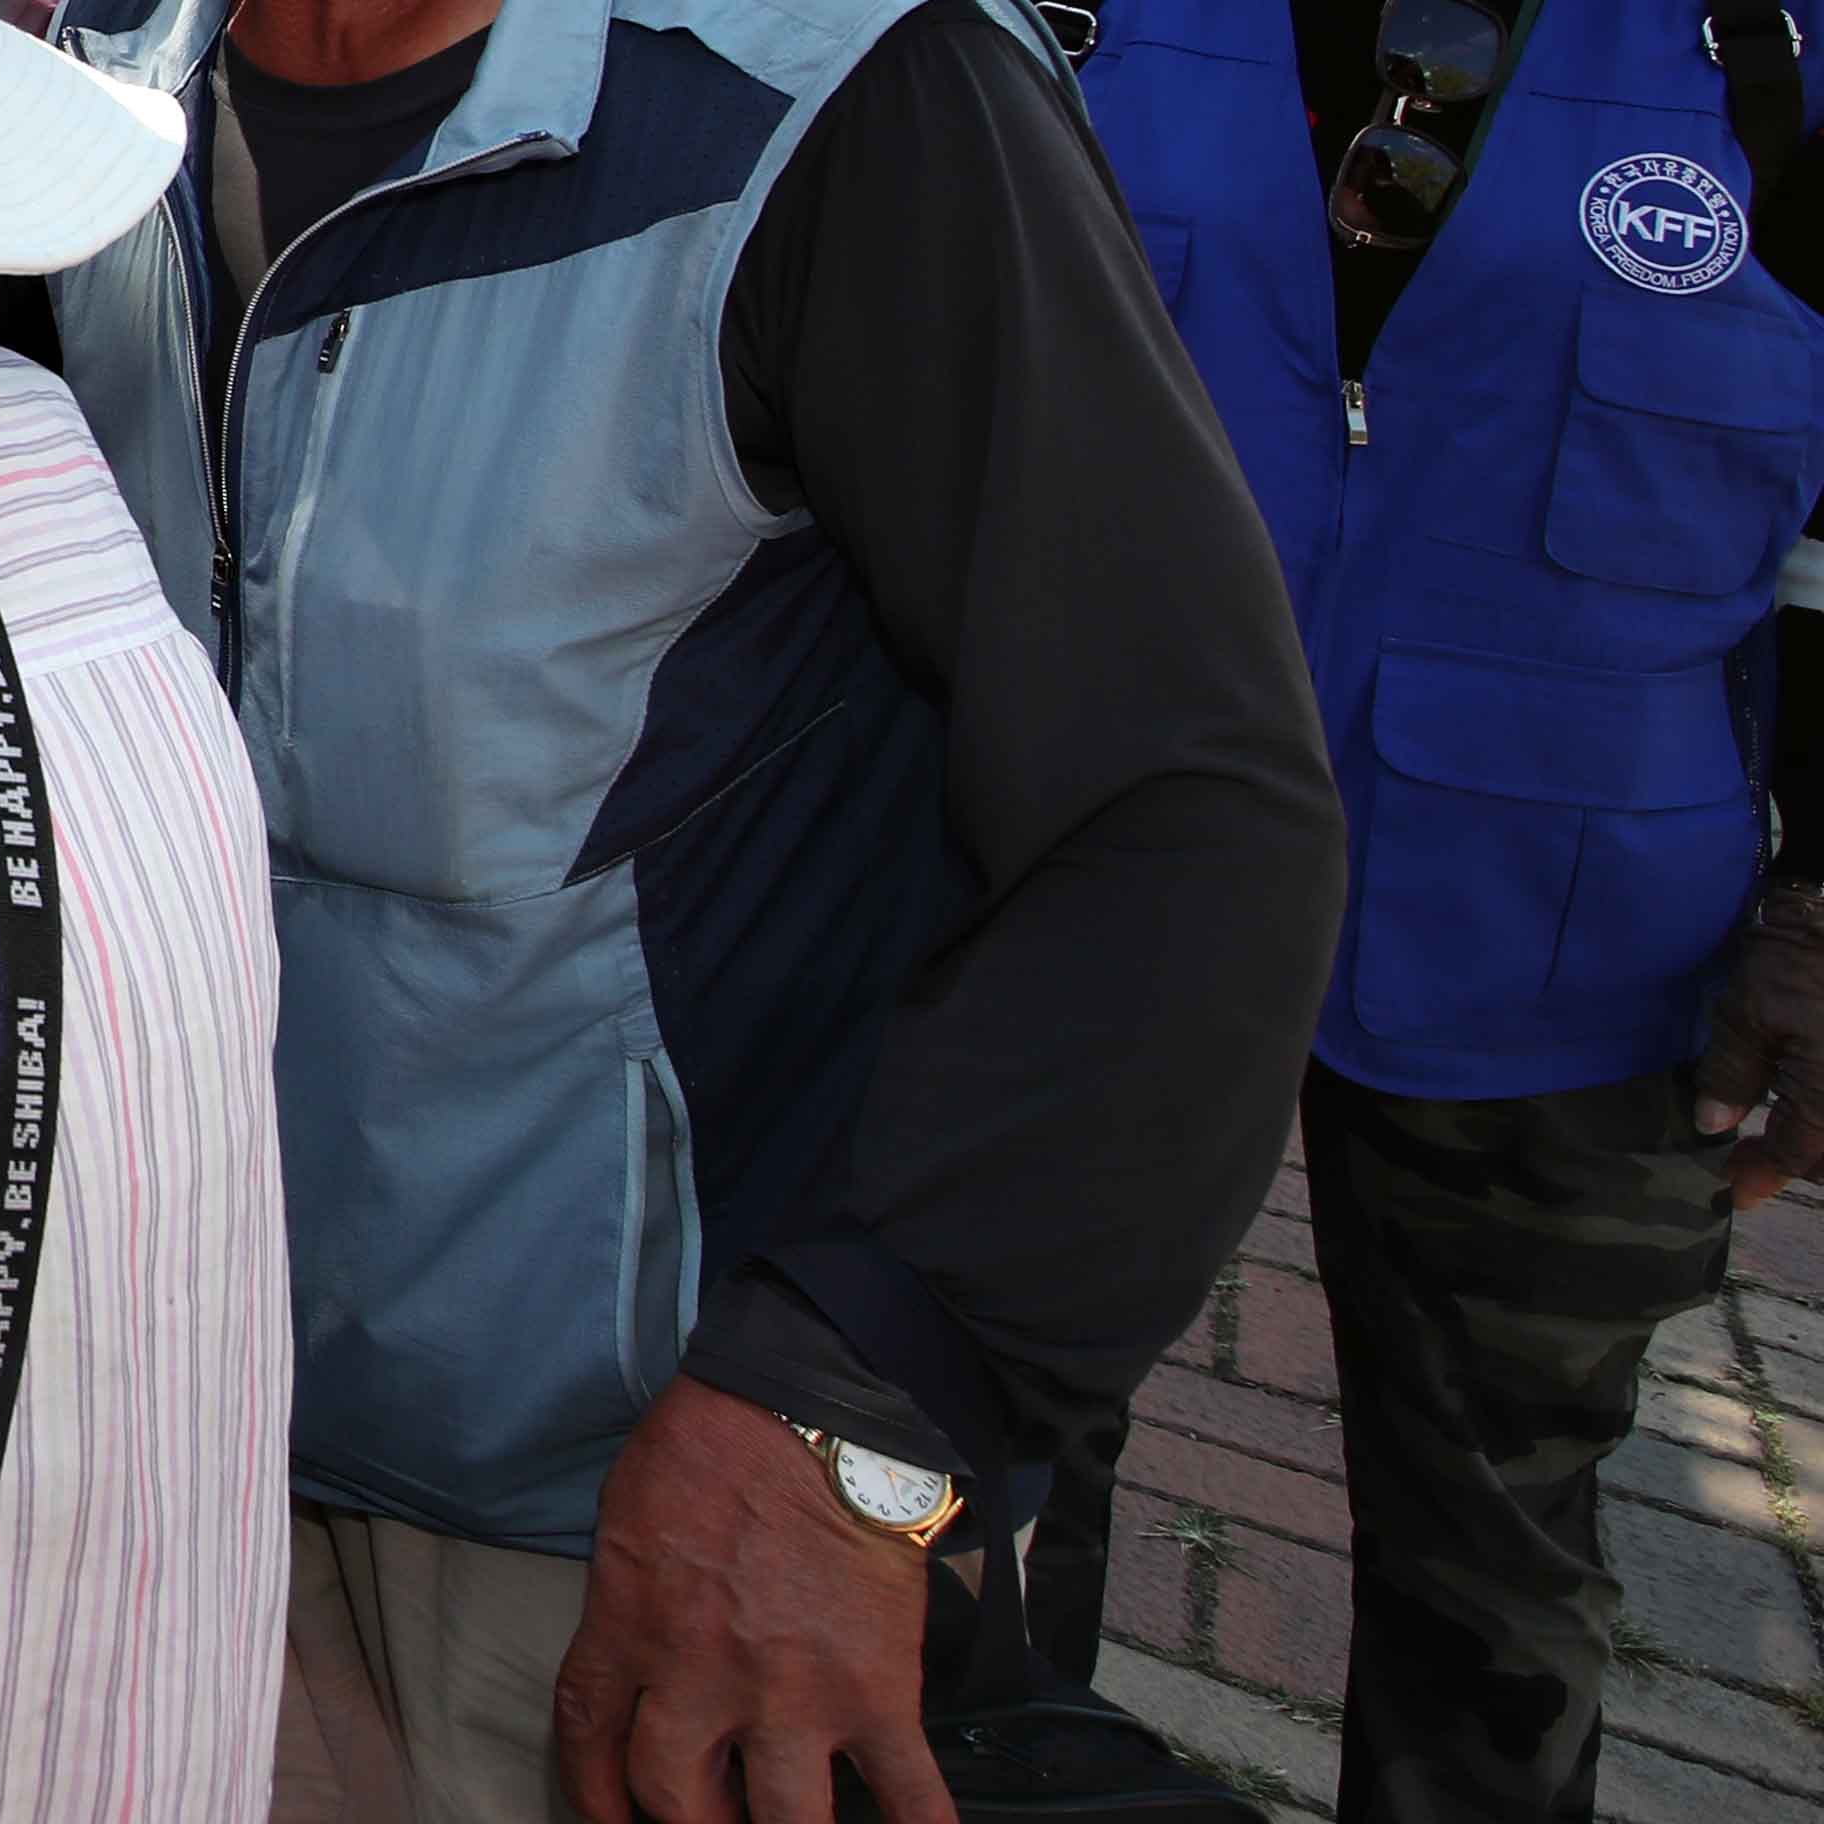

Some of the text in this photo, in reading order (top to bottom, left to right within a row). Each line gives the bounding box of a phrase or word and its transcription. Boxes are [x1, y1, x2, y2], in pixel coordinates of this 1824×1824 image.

[1589, 196, 1609, 245] KOREA
[1605, 244, 1677, 288] FREEDOM
[1617, 199, 1715, 249] KFF
[6, 855, 43, 909] BE
[13, 997, 47, 1149] SHIBA!
[4, 1160, 37, 1211] BE
